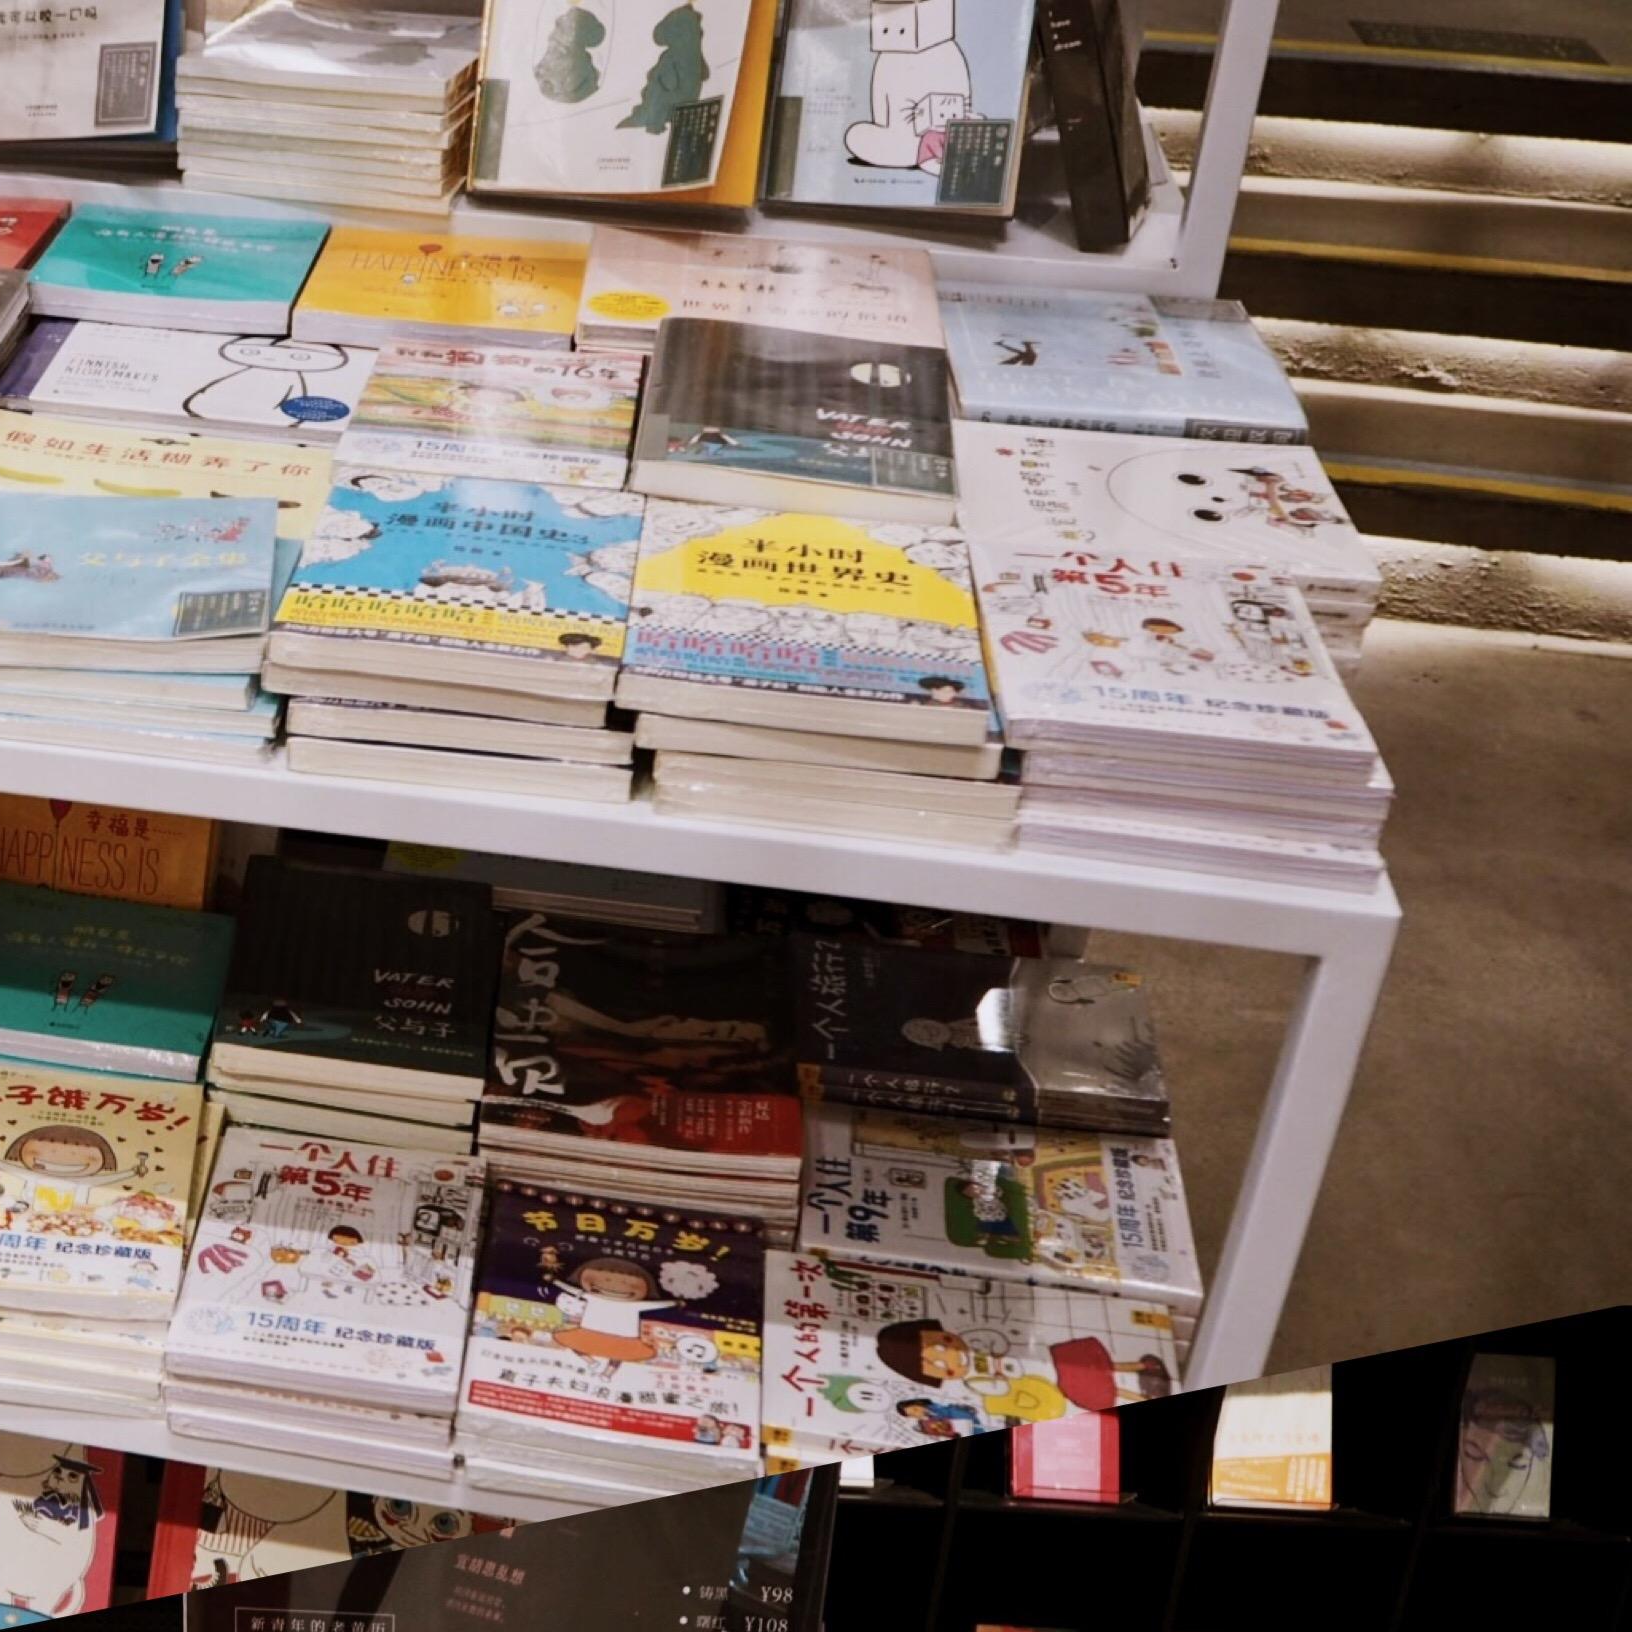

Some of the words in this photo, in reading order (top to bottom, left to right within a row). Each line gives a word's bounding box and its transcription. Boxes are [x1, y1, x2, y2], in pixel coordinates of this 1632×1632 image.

[696, 551, 914, 587] 漫画世界史
[743, 536, 867, 564] 半小时
[134, 848, 162, 897] IS
[373, 966, 457, 990] VATER
[383, 997, 453, 1017] SOHN
[373, 1014, 458, 1041] 父与子
[259, 1139, 402, 1180] 一个人住
[278, 1164, 375, 1204] 第5年
[806, 1156, 854, 1236] 一个人住
[844, 1187, 893, 1244] 第9年
[53, 1238, 154, 1264] 纪念珍藏版
[246, 1310, 328, 1336] 15周年
[333, 1324, 438, 1353] 纪念珍藏版
[779, 1258, 831, 1418] 一个人的第一次
